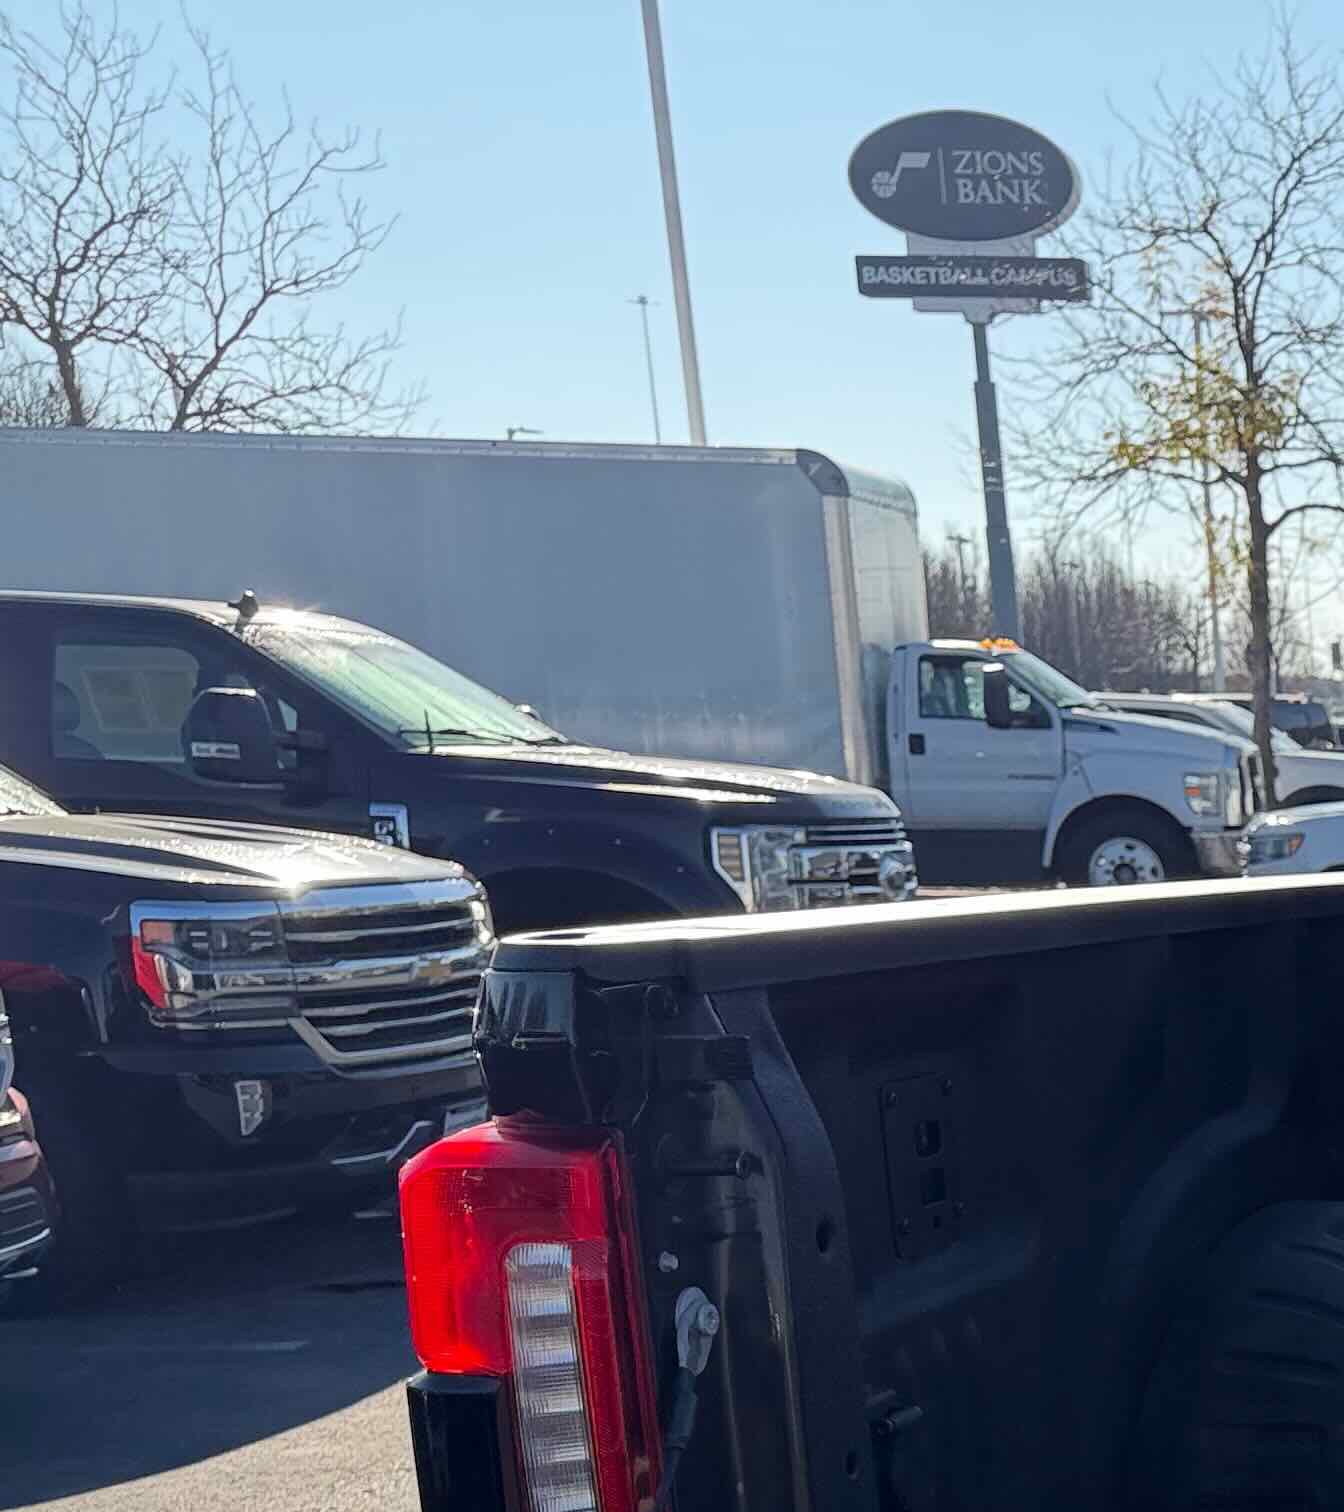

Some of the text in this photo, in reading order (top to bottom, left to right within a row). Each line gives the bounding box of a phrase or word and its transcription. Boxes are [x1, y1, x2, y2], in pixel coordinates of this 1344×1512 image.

[951, 150, 1045, 175] ZIONS
[956, 179, 1047, 204] BANK
[862, 265, 989, 284] BASKETBALL
